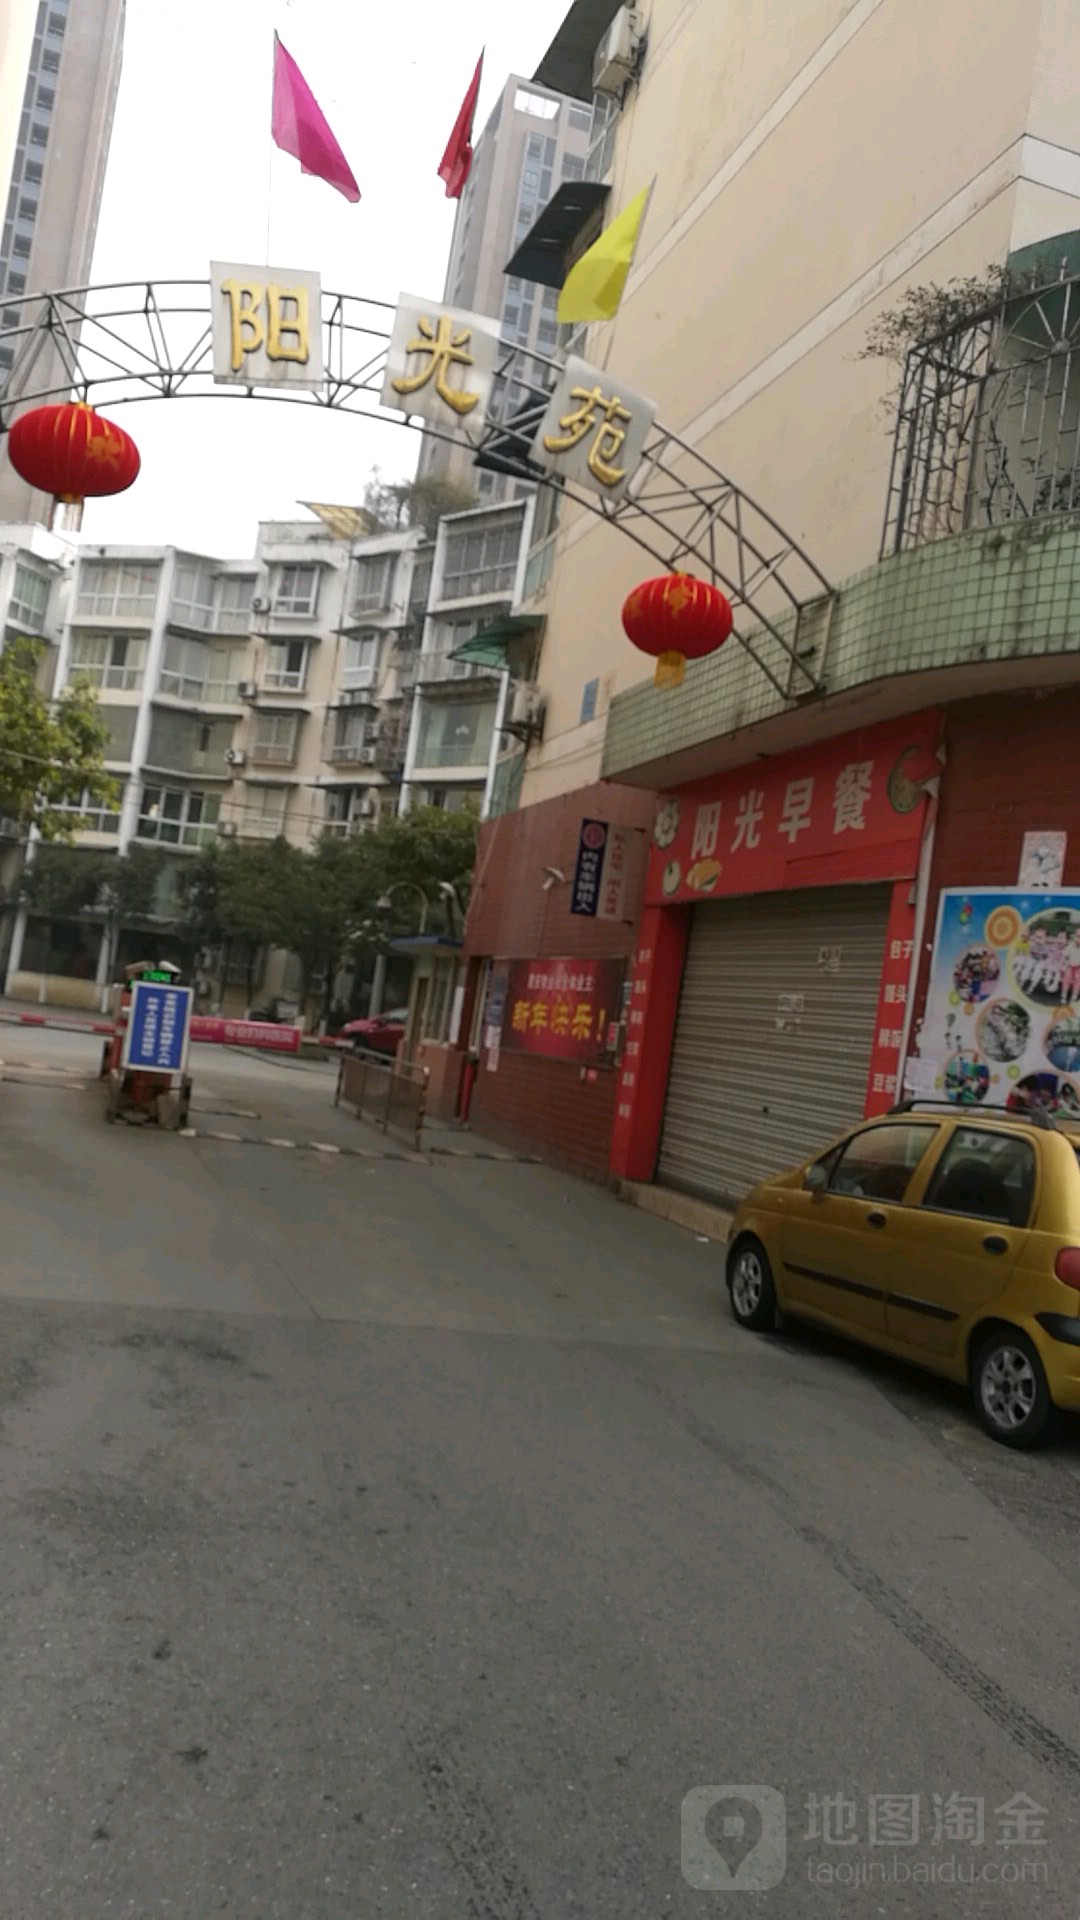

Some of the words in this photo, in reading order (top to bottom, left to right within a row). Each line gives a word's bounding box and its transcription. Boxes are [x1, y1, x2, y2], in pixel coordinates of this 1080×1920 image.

[221, 276, 633, 486] 阳光苑
[690, 759, 875, 860] 阳光早餐
[889, 939, 914, 960] 包子
